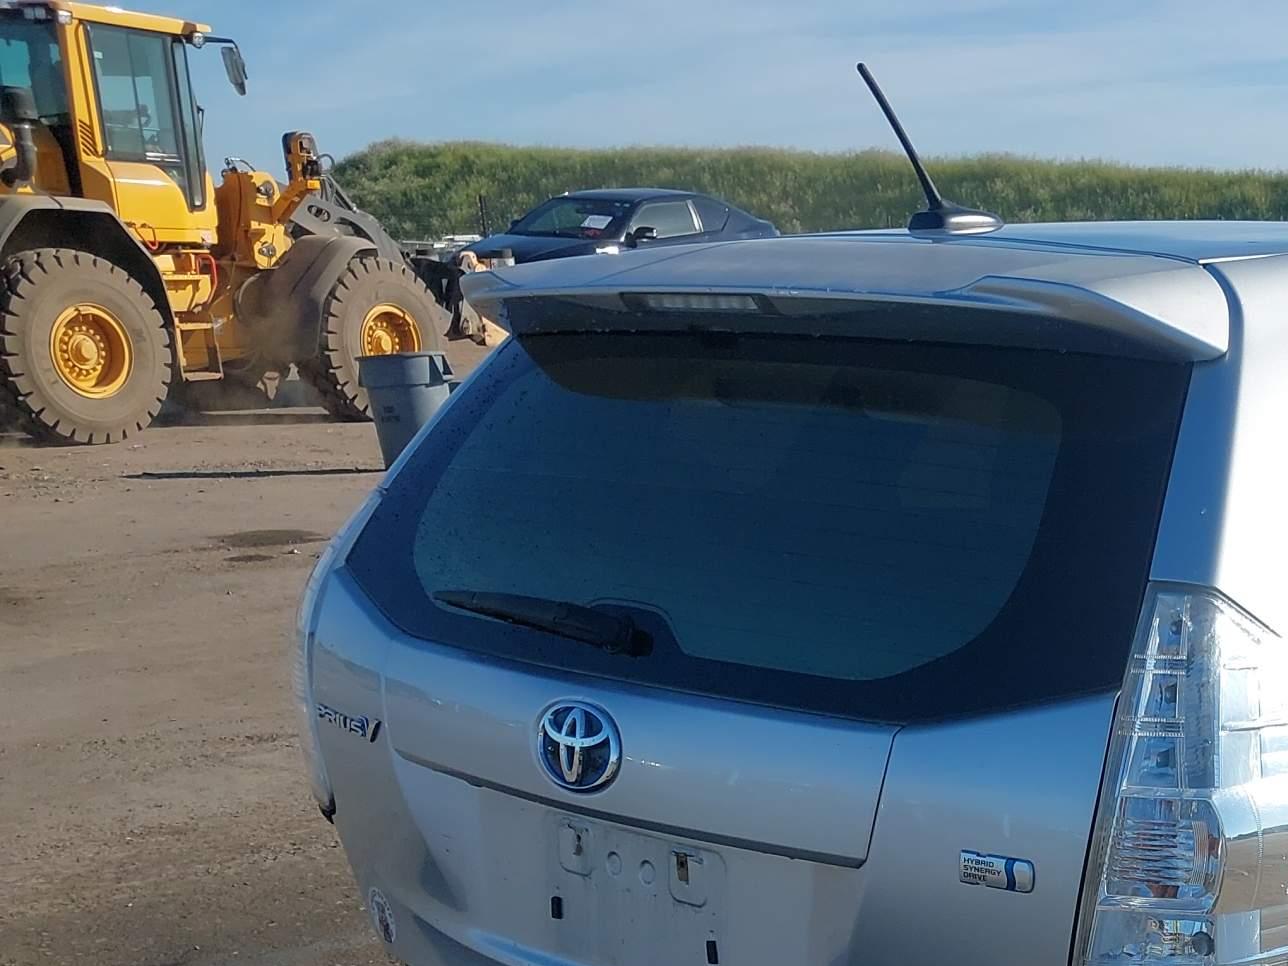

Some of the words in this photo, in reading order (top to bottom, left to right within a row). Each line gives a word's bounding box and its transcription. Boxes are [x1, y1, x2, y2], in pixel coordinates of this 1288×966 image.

[963, 857, 995, 868] HYBRID
[963, 864, 1002, 877] SYNERGY
[963, 872, 987, 882] DRIVE
